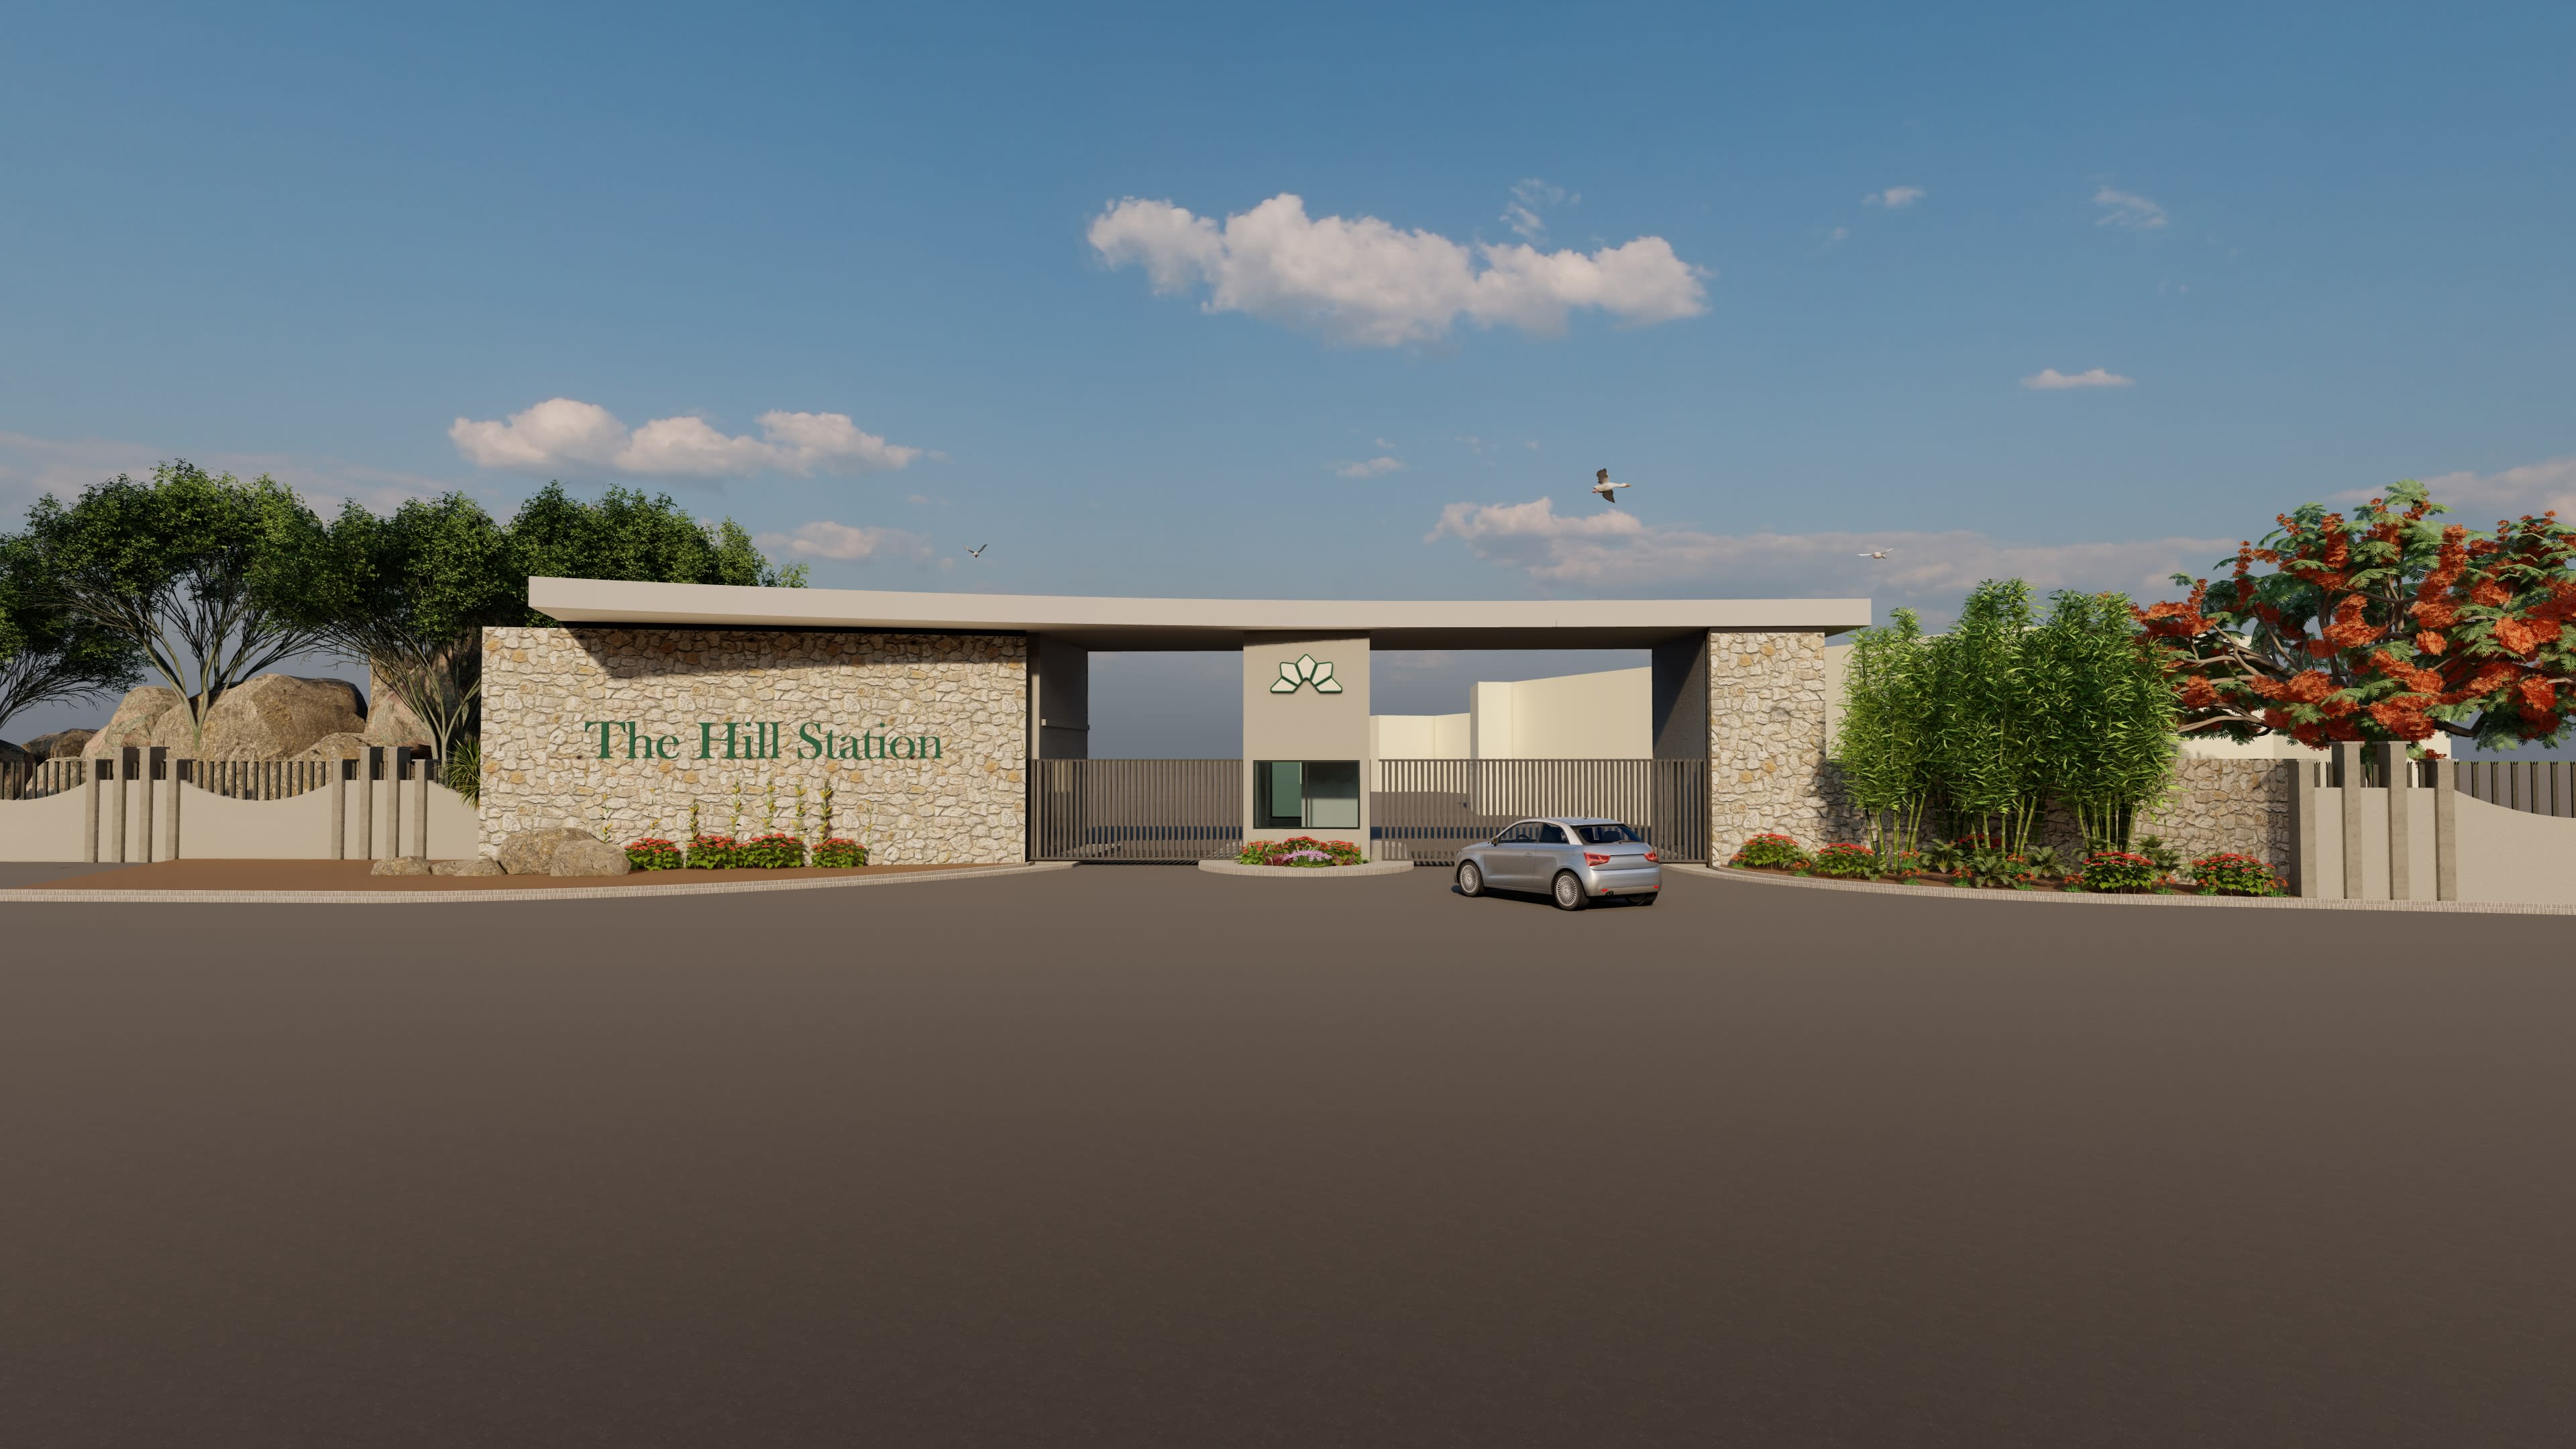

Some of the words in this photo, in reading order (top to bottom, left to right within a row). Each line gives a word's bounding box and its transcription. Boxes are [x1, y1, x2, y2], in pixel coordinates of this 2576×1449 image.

[584, 720, 680, 759] The
[697, 721, 781, 759] Hill
[797, 721, 943, 760] Station
